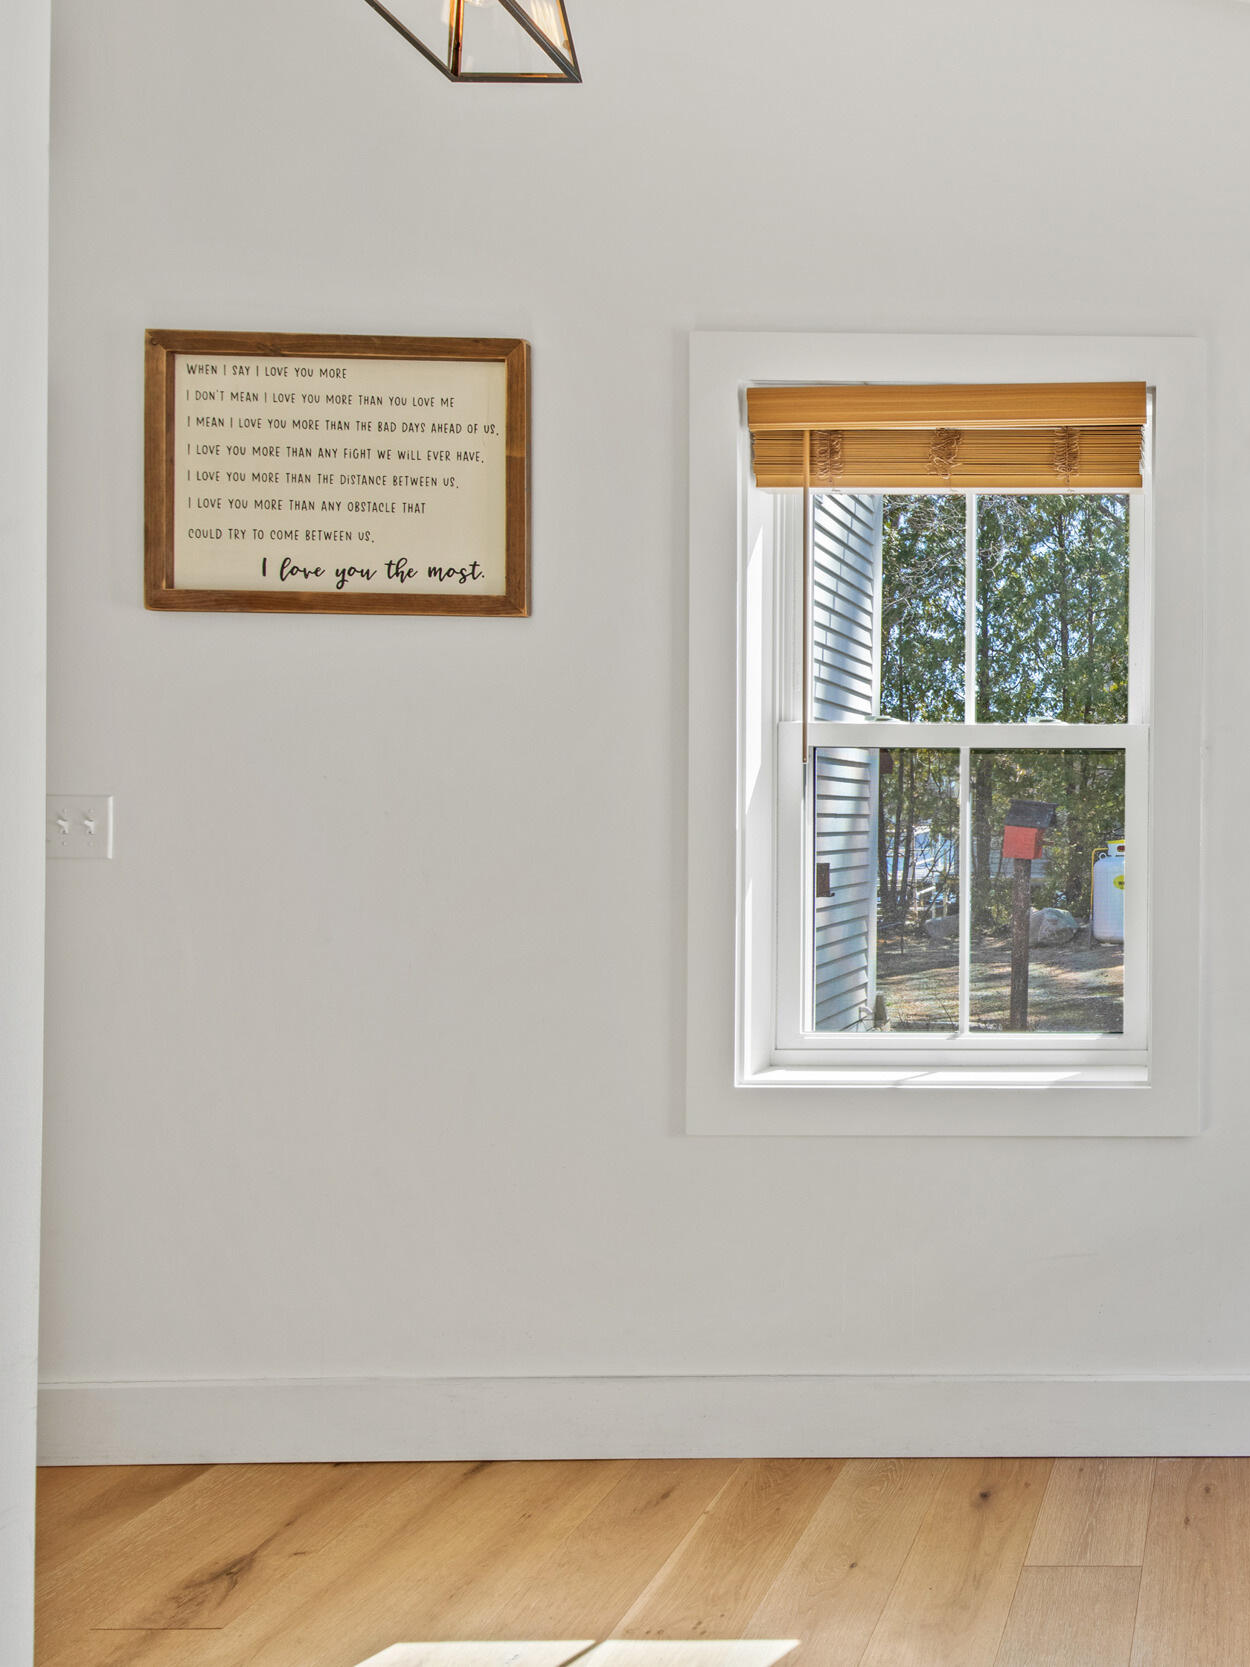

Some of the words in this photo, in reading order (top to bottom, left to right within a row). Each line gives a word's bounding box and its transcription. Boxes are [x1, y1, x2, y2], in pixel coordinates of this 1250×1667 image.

[187, 364, 217, 375] WHEN
[232, 365, 250, 375] SAY
[265, 367, 288, 377] LOVE
[294, 368, 313, 377] YOU
[320, 368, 347, 379] MORE
[195, 390, 224, 401] DON'T
[230, 392, 258, 402] MEAN
[273, 393, 296, 403] LOVE
[302, 394, 320, 404] YOU
[326, 394, 352, 405] MORE
[359, 395, 382, 405] THAN
[389, 394, 407, 406] YOU
[413, 397, 435, 407] LOVE
[441, 397, 455, 407] ME
[196, 417, 224, 427] MEAN
[239, 418, 262, 429] LOVE
[268, 419, 286, 429] YOU
[292, 418, 319, 430] MORE
[325, 420, 350, 431] THAN
[356, 421, 372, 432] THE
[378, 421, 396, 432] BAD
[402, 422, 425, 433] DAYS
[431, 423, 462, 434] AHEAD
[467, 424, 478, 434] OF
[484, 424, 499, 436] US.
[196, 444, 220, 455] LOVE
[226, 446, 246, 456] YOU
[252, 446, 280, 457] MORE
[286, 446, 312, 458] THAN
[318, 448, 337, 458] ANY
[377, 449, 392, 460] WE
[427, 450, 451, 461] EVER
[457, 451, 484, 463] HAVE.
[197, 471, 220, 482] LOVE
[226, 472, 246, 482] YOU
[252, 472, 279, 483] MORE
[285, 473, 311, 483] THAN
[317, 473, 334, 484] THE
[393, 475, 439, 487] BETWEEN
[443, 477, 458, 488] US.
[198, 498, 222, 511] LOVE
[228, 499, 248, 509] YOU
[254, 499, 283, 510] MORE
[289, 500, 315, 511] THAN
[321, 500, 341, 512] ANY
[347, 499, 396, 513] OBSTACLE
[402, 502, 426, 514] THAT
[188, 528, 222, 539] COULD
[228, 528, 246, 540] TRY
[253, 529, 264, 540] TO
[270, 530, 299, 540] COME
[305, 530, 352, 541] BETWEEN
[358, 531, 374, 543] US.
[261, 556, 268, 577] I
[280, 557, 325, 582] love
[335, 566, 377, 589] you
[384, 557, 418, 584] the
[428, 561, 485, 584] most.
